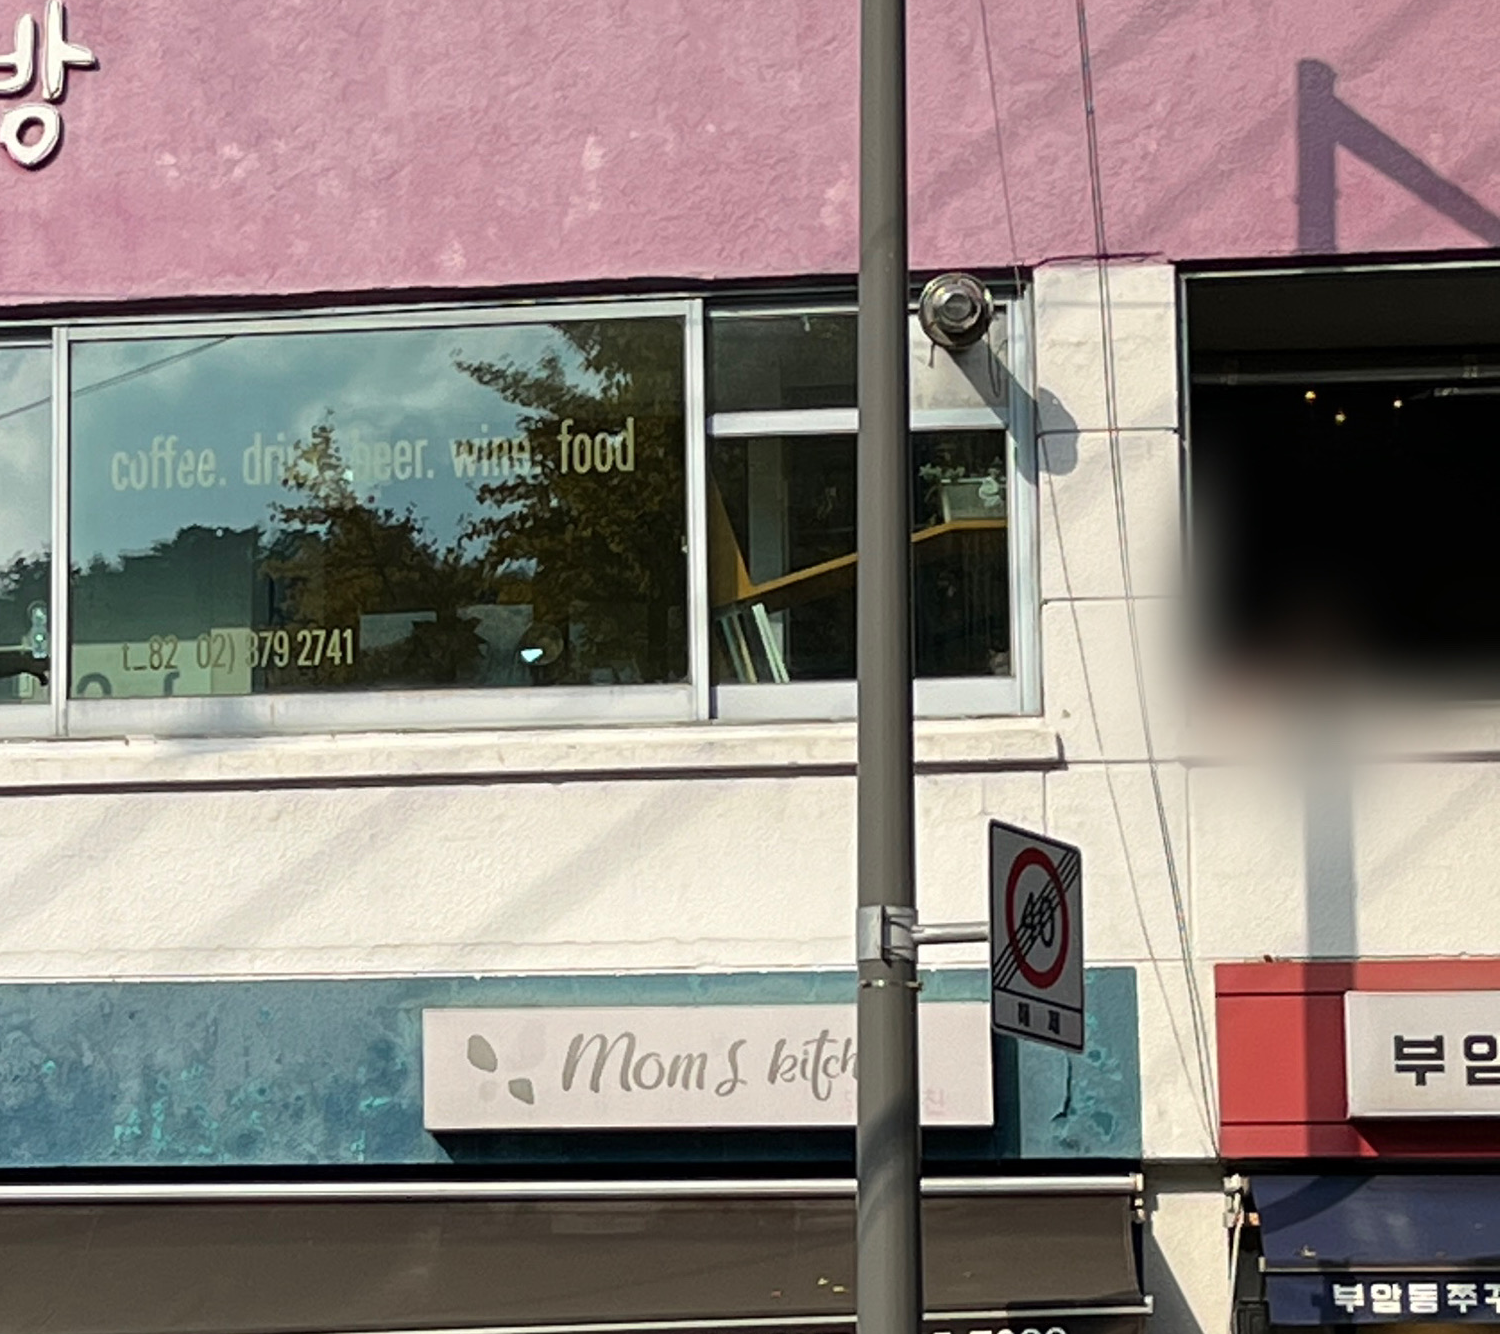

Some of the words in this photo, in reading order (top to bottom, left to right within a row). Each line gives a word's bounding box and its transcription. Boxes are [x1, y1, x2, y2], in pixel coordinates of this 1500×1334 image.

[111, 434, 226, 491] coffee.
[557, 416, 635, 475] food
[196, 632, 236, 674] 02)
[296, 628, 354, 668] 2741
[767, 1029, 857, 1101] kitch
